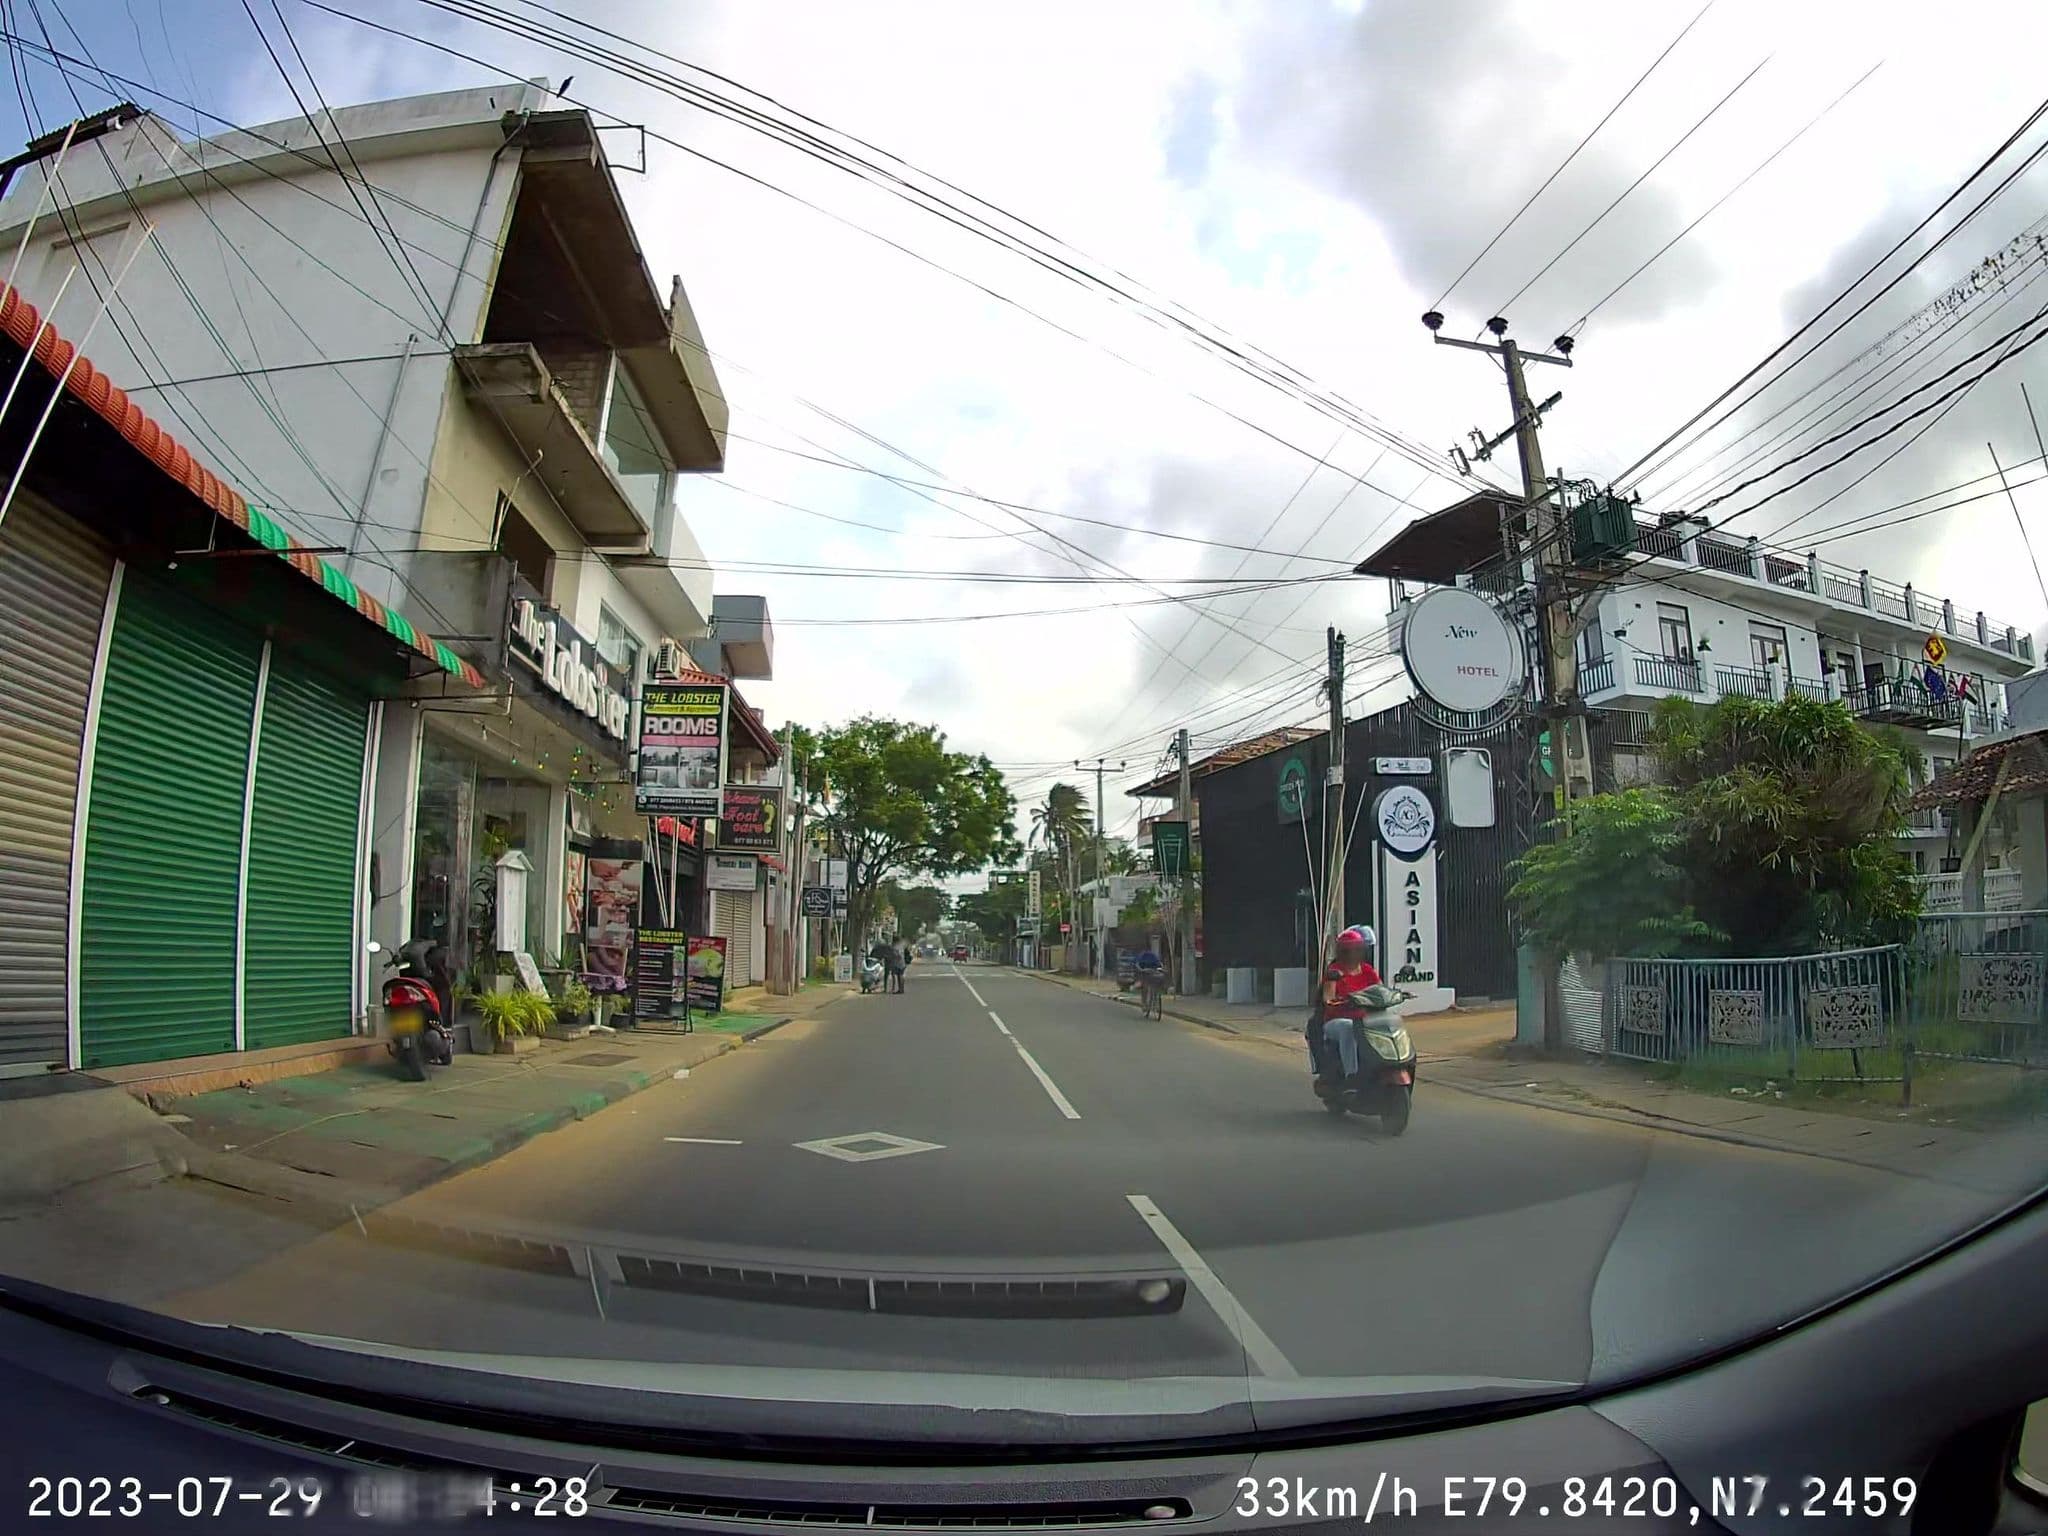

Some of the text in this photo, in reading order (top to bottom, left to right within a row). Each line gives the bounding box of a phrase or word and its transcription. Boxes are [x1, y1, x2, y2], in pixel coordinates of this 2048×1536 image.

[512, 600, 545, 654] The
[1445, 625, 1478, 639] New
[1457, 665, 1499, 677] HOTEL
[645, 692, 721, 704] THE LOBSTER
[644, 716, 718, 735] ROOMS
[1405, 871, 1421, 964] ASIAN
